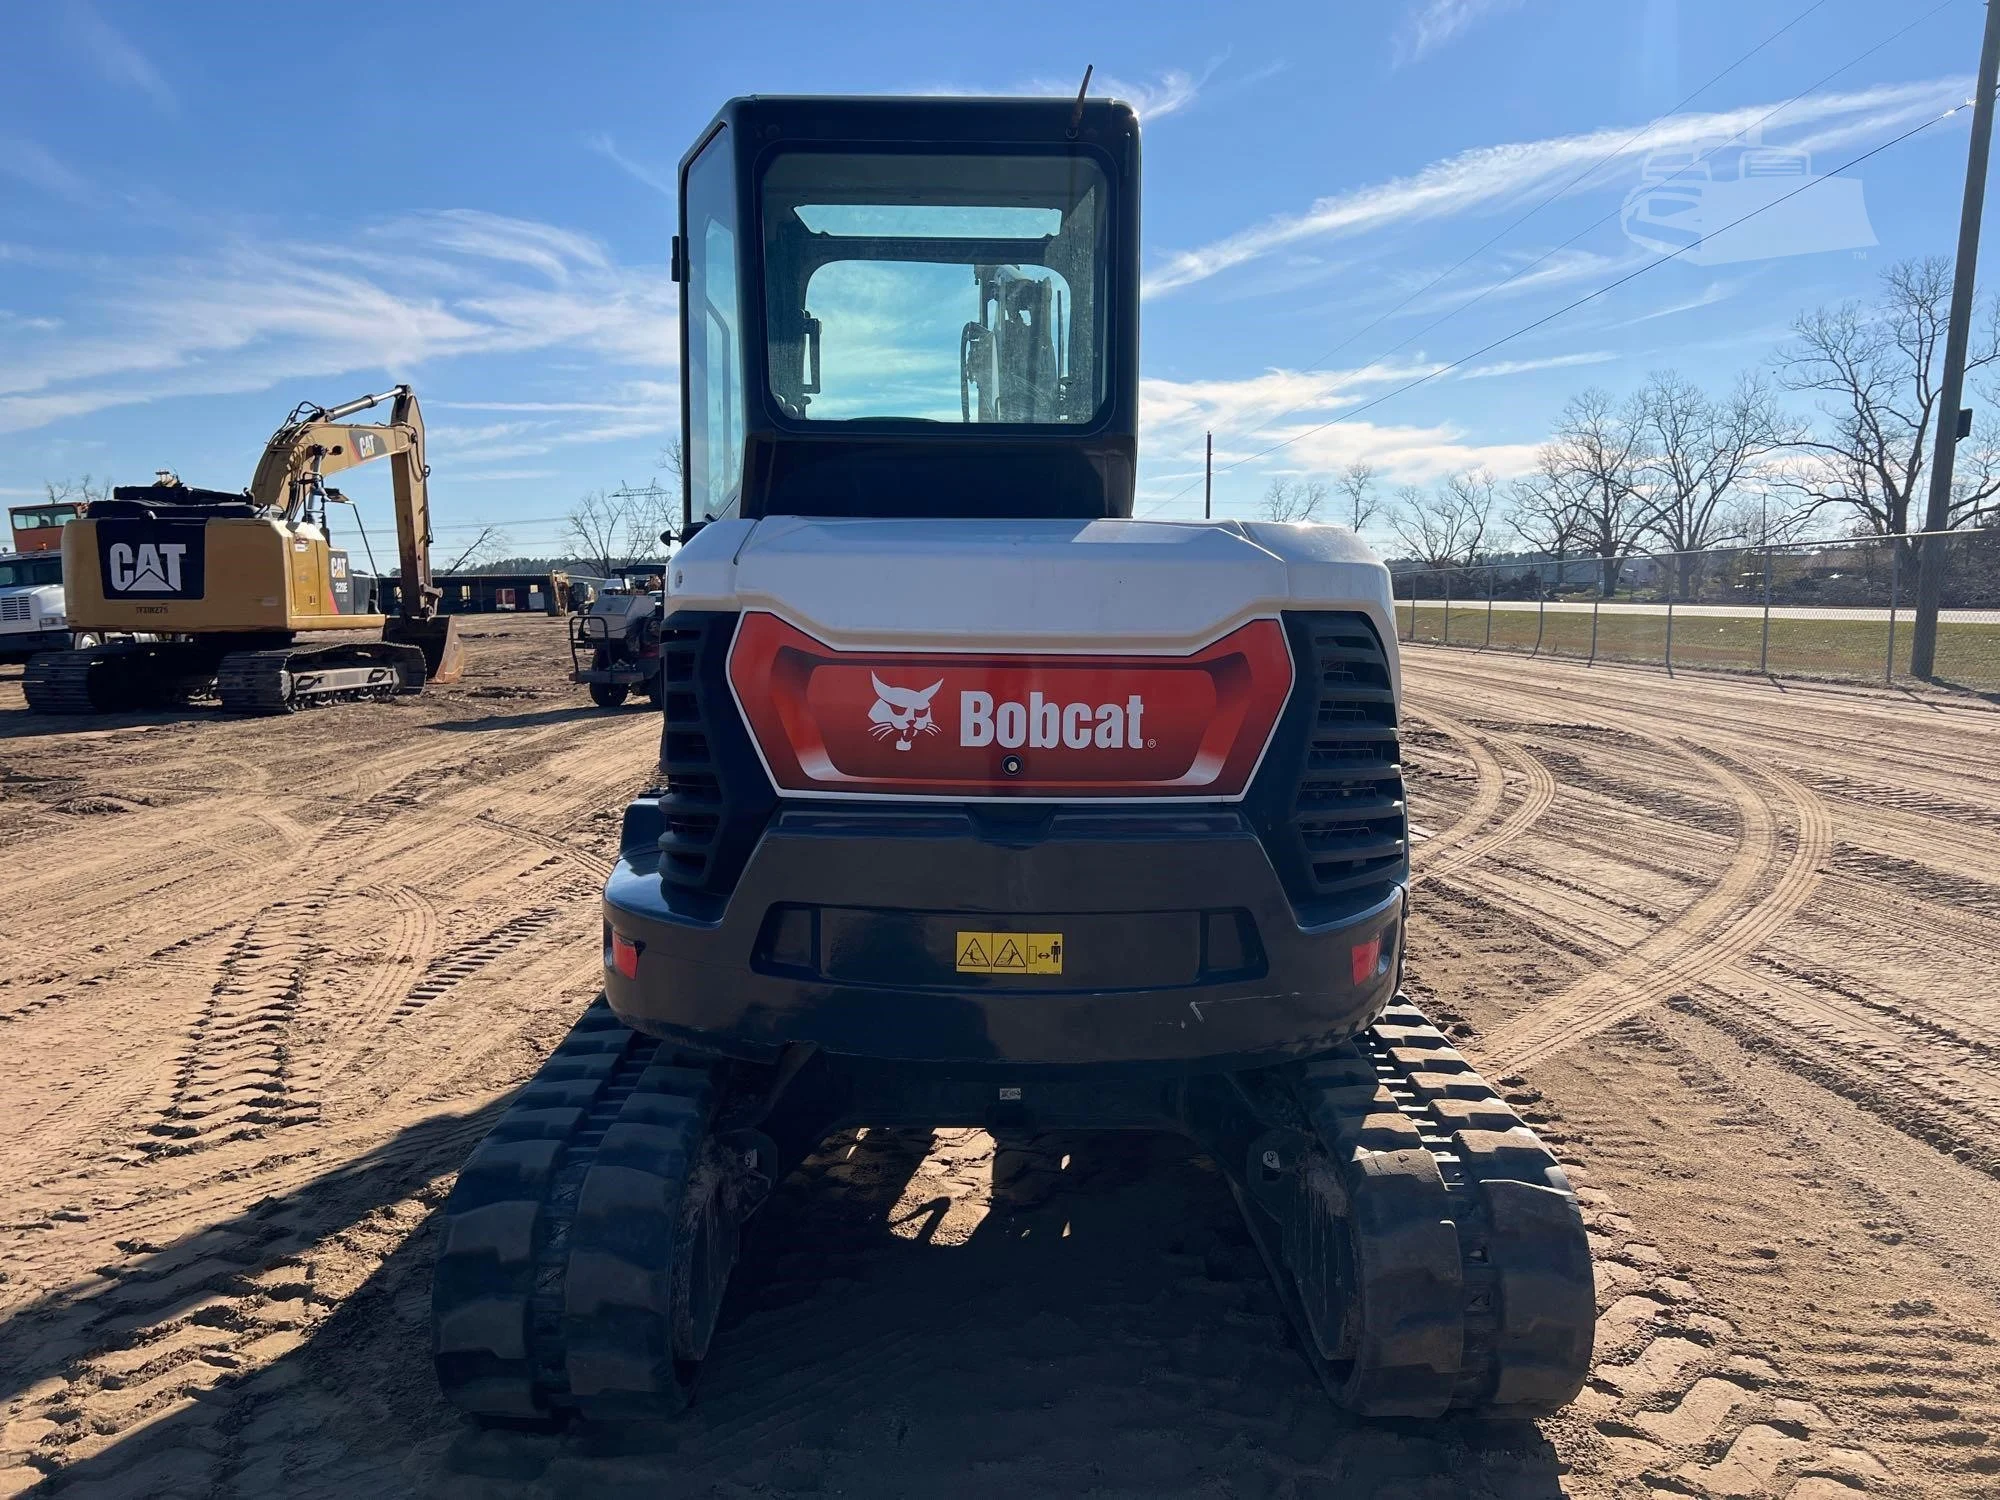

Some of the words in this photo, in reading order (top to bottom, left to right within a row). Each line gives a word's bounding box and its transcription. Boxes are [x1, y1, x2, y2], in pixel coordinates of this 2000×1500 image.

[360, 435, 375, 458] CAT
[110, 543, 186, 591] CAT
[331, 557, 347, 578] CAT
[960, 690, 1144, 749] Bobcat
